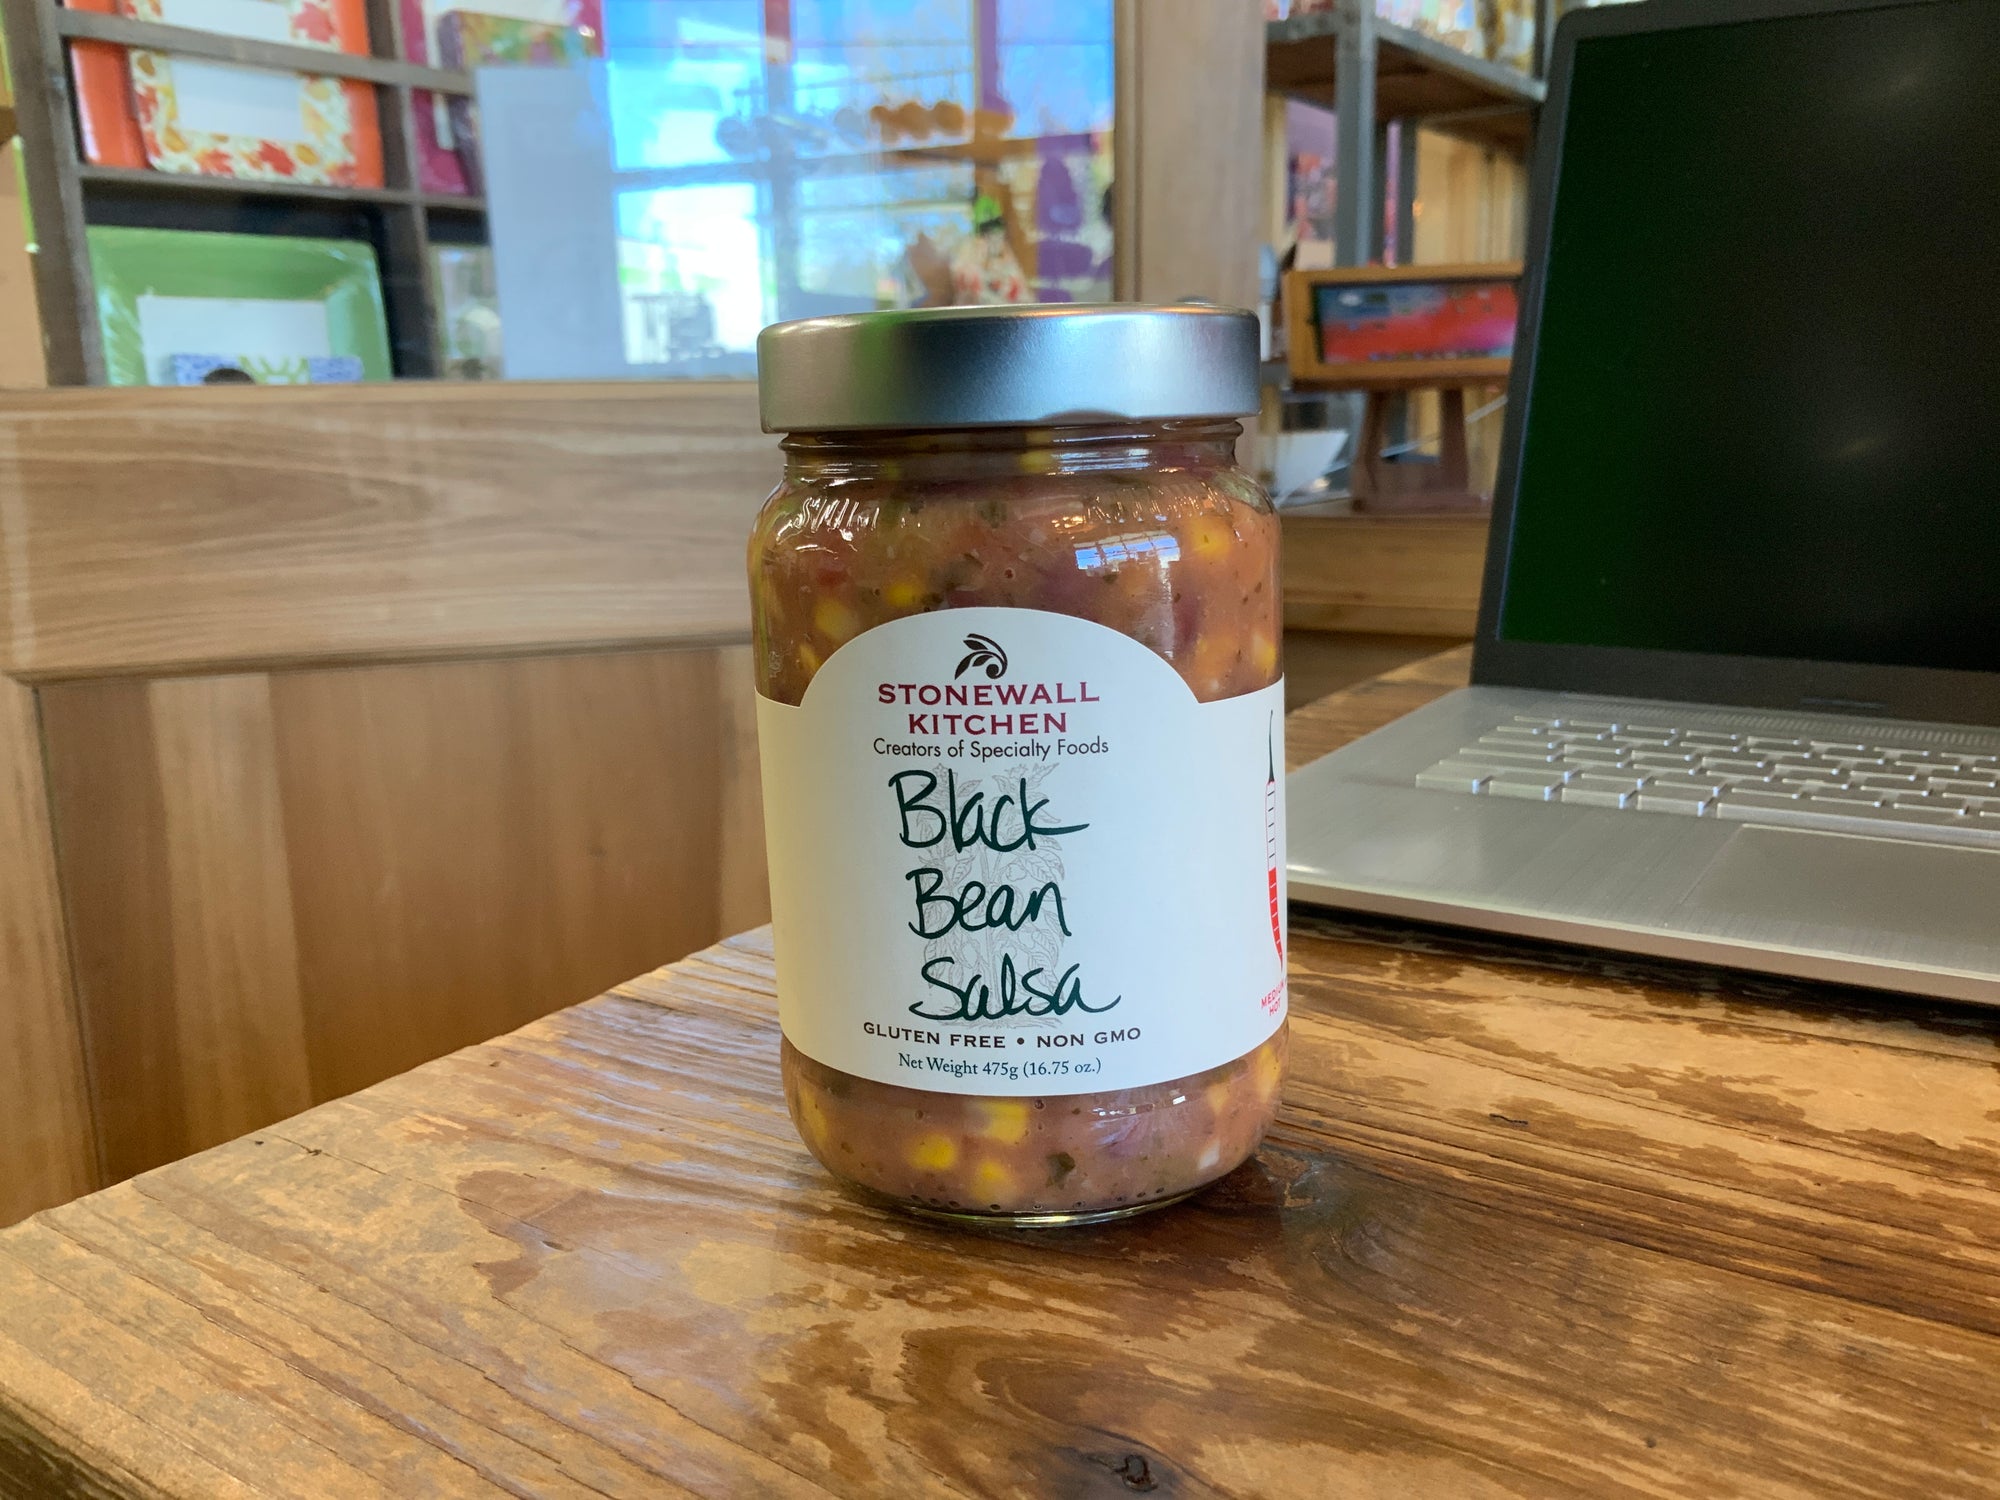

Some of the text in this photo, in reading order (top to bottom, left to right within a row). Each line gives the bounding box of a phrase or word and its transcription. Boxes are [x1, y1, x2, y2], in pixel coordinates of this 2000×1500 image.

[877, 681, 1101, 706] STONEWALL
[908, 712, 1067, 735] KITCHEN
[873, 736, 1109, 763] Creators of Specialty Foods
[888, 768, 1090, 854] Black
[905, 867, 1073, 940] Bean
[908, 952, 1122, 1021] Salsa
[1268, 998, 1281, 1016] HOT
[863, 1022, 1142, 1048] GLUTEN FREE NON GMO
[898, 1053, 1102, 1080] Net Weight 475g (16.75 oz.)
